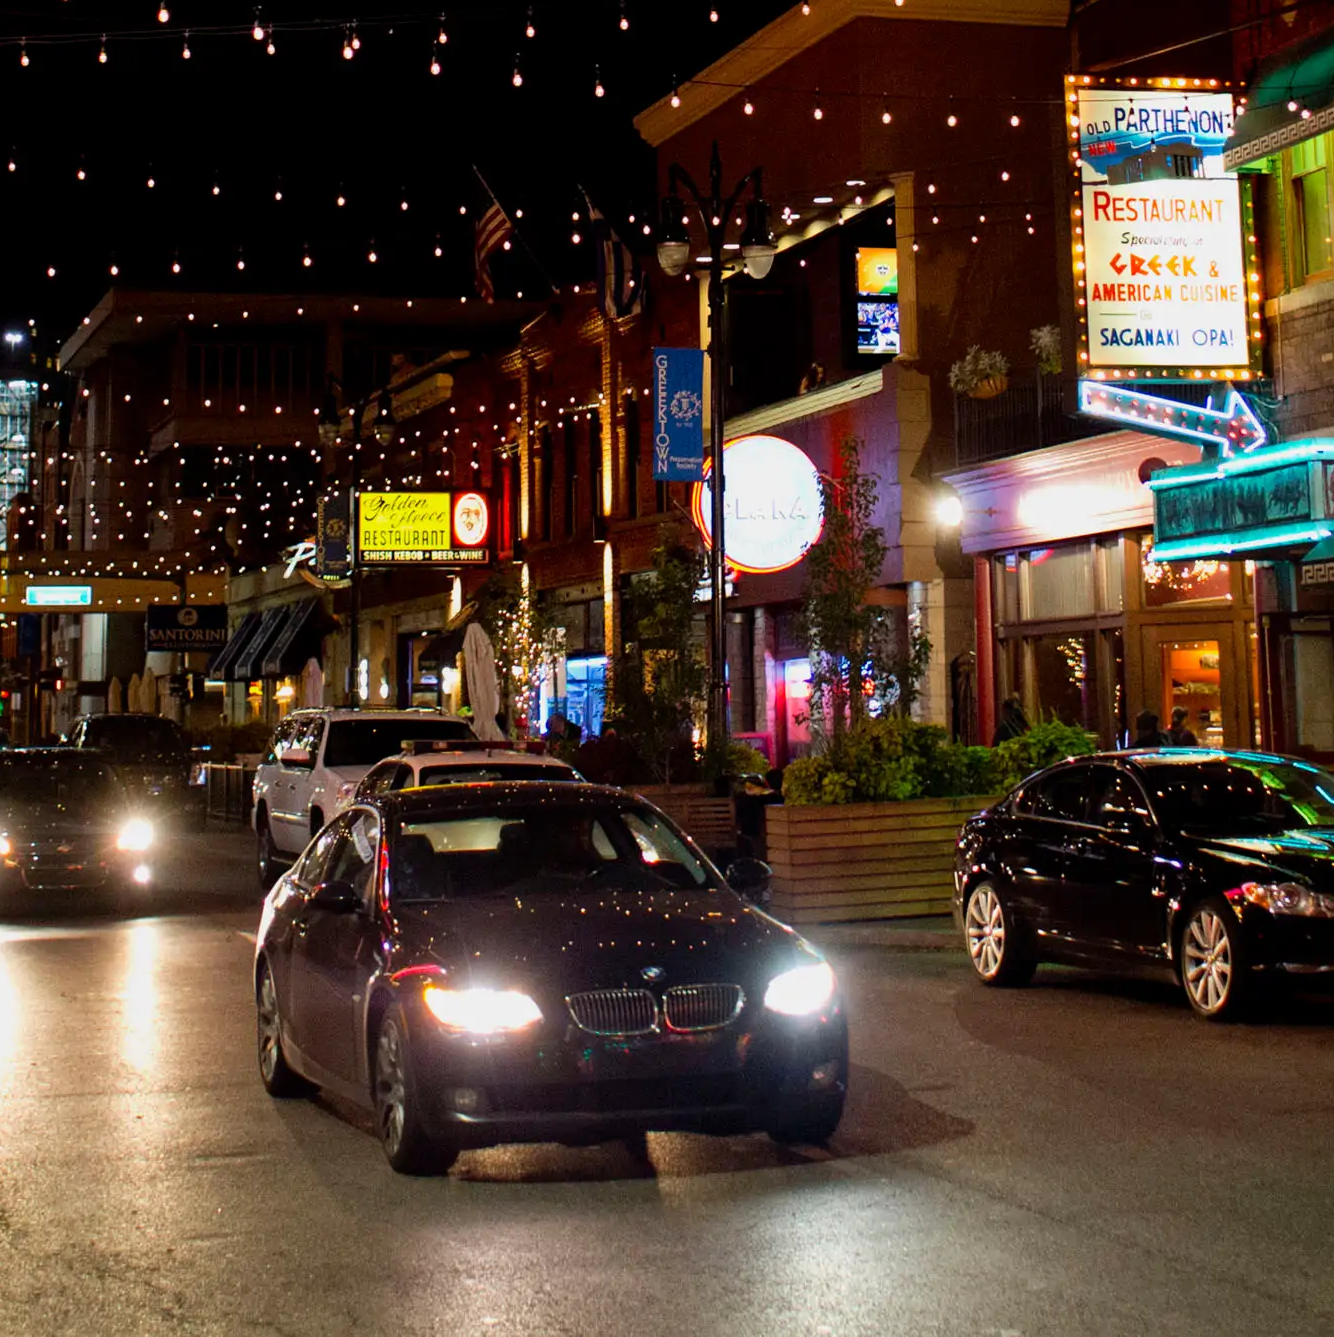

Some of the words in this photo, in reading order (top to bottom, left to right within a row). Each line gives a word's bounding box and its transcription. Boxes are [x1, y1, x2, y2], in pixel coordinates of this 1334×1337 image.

[1086, 120, 1111, 136] OLD
[1114, 107, 1224, 134] PARTHENON
[1092, 190, 1224, 223] RESTAURANT
[1109, 252, 1198, 277] GREEK
[1209, 260, 1220, 278] &
[1092, 282, 1173, 302] AMERICAN
[1180, 284, 1240, 303] CUISINE
[1100, 327, 1180, 348] SAGANAKI
[1192, 328, 1235, 348] OPA!
[656, 355, 670, 474] GREEKTOWN
[363, 494, 428, 522] Golden
[363, 530, 446, 546] RESTAURANT
[363, 550, 393, 561] SHISH
[394, 550, 424, 561] KEBOB
[149, 628, 226, 642] SANTORINI
